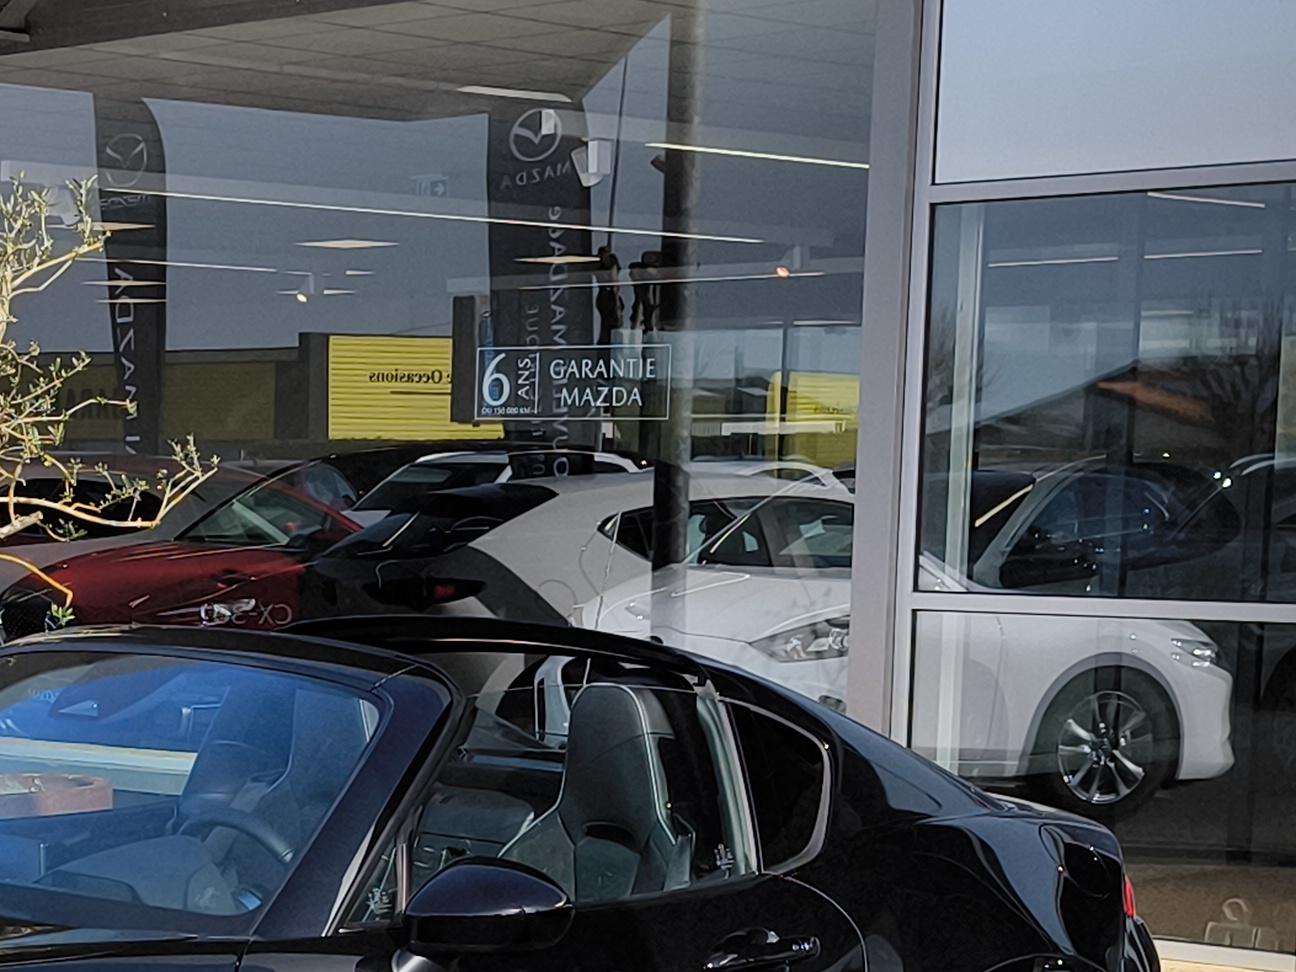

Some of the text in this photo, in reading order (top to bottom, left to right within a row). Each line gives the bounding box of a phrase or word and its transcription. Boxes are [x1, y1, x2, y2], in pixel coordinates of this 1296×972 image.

[549, 358, 656, 379] GARANTIE
[482, 353, 511, 407] 6
[517, 358, 532, 400] ANS
[560, 386, 643, 407] MAZDA
